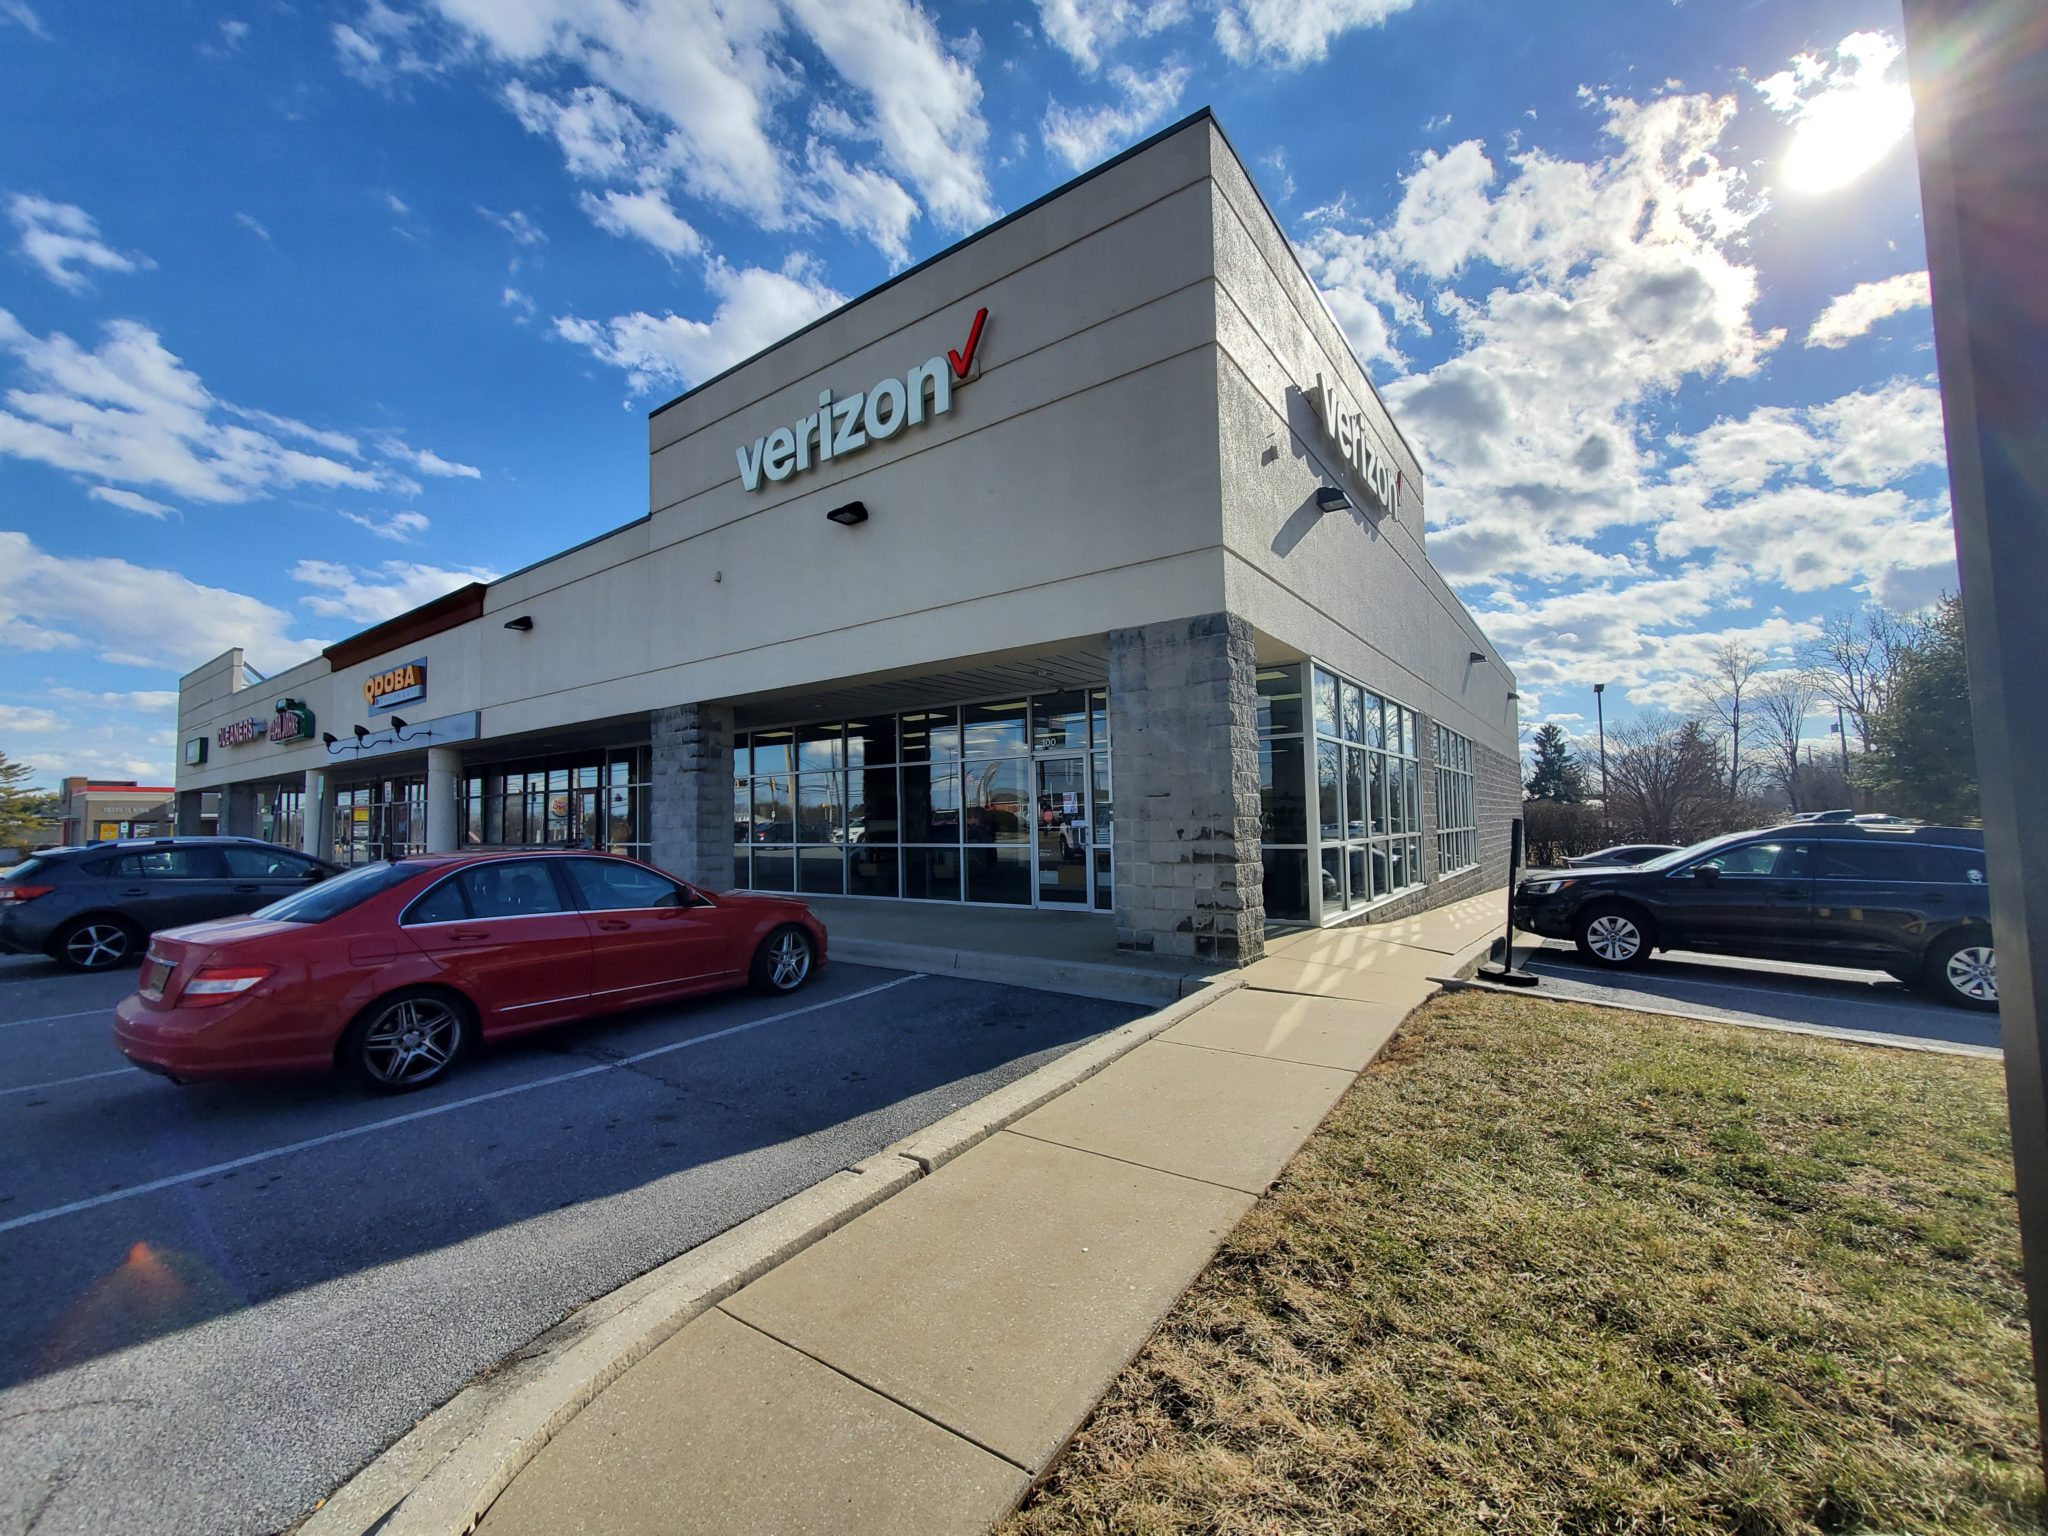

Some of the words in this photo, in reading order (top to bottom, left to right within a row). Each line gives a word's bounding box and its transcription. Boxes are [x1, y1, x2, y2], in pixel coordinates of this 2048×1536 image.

[735, 356, 951, 492] verizon
[1317, 372, 1400, 522] verizon
[364, 665, 415, 705] QDOBA
[218, 717, 254, 748] CLEANERS
